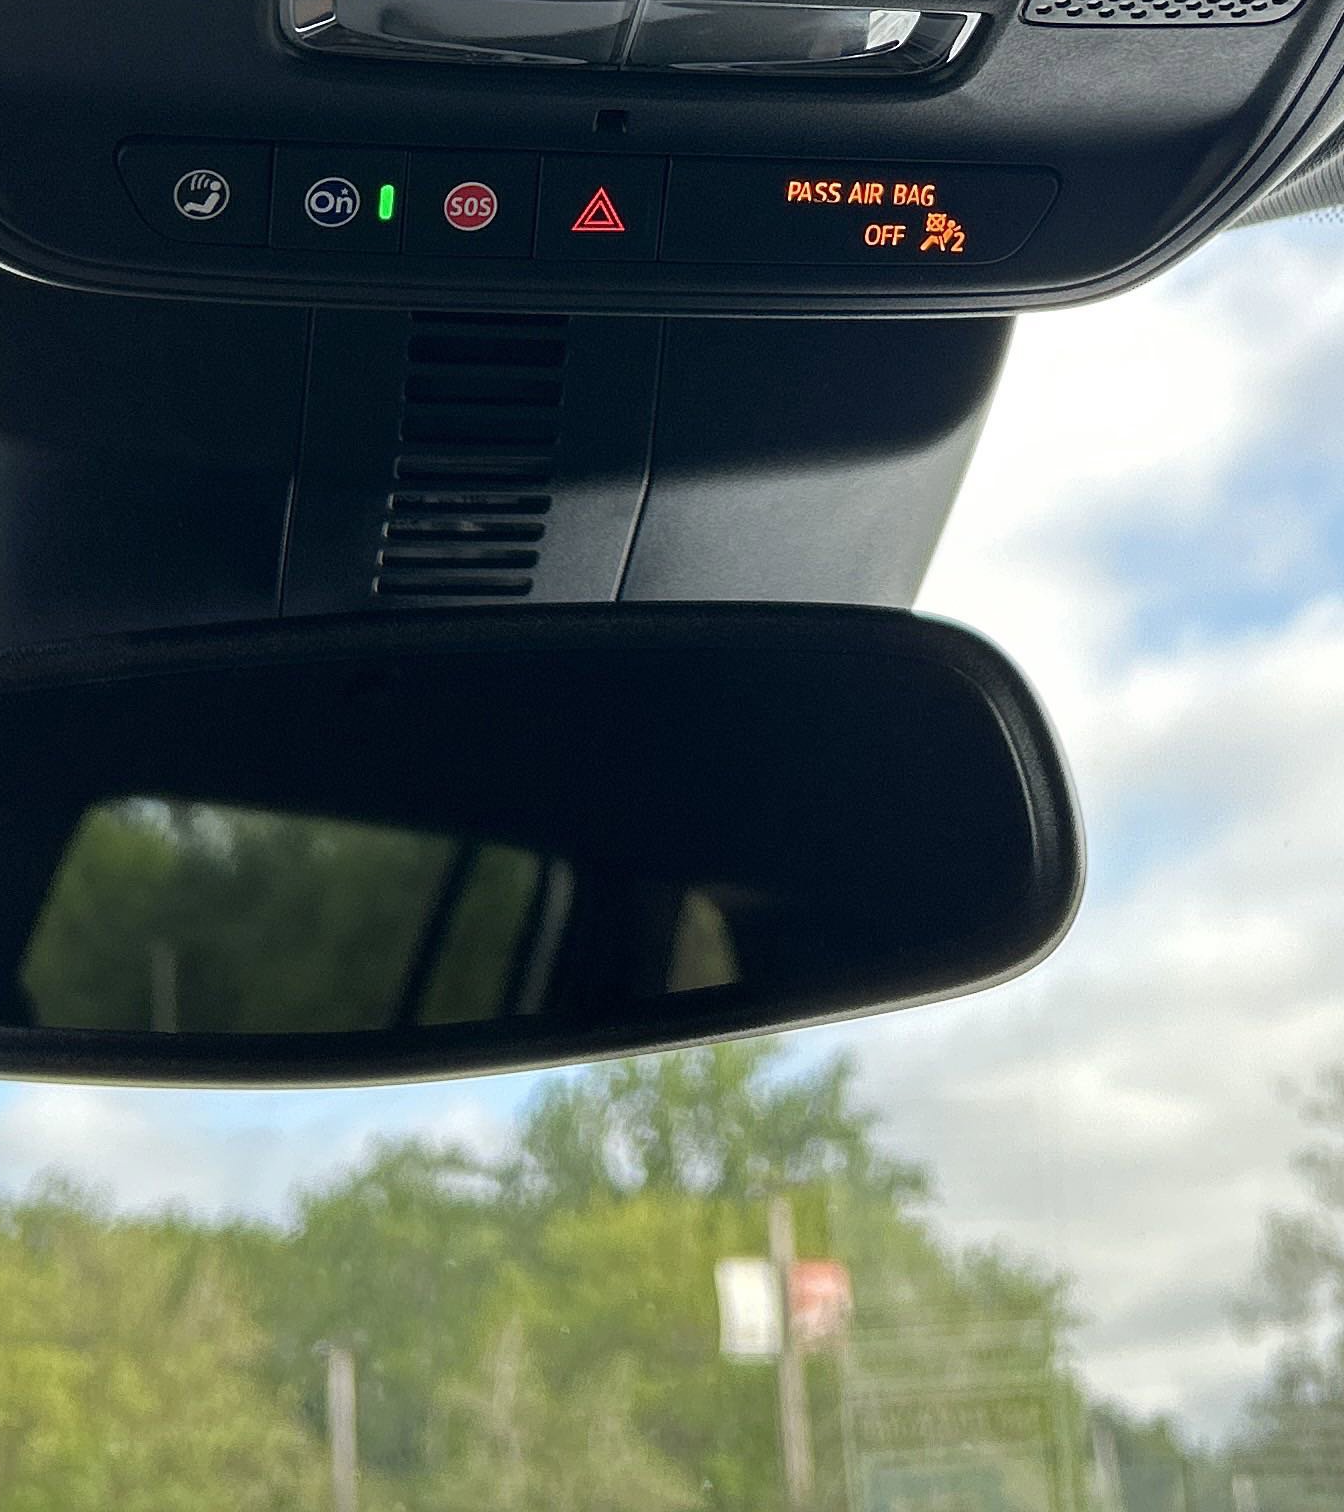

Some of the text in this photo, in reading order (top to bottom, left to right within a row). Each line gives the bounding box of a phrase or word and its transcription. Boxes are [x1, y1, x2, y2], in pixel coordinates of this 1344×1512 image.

[310, 188, 353, 214] On
[787, 181, 936, 206] PASS AIR BAG
[449, 196, 491, 217] SOS
[864, 224, 966, 252] OFF 2
